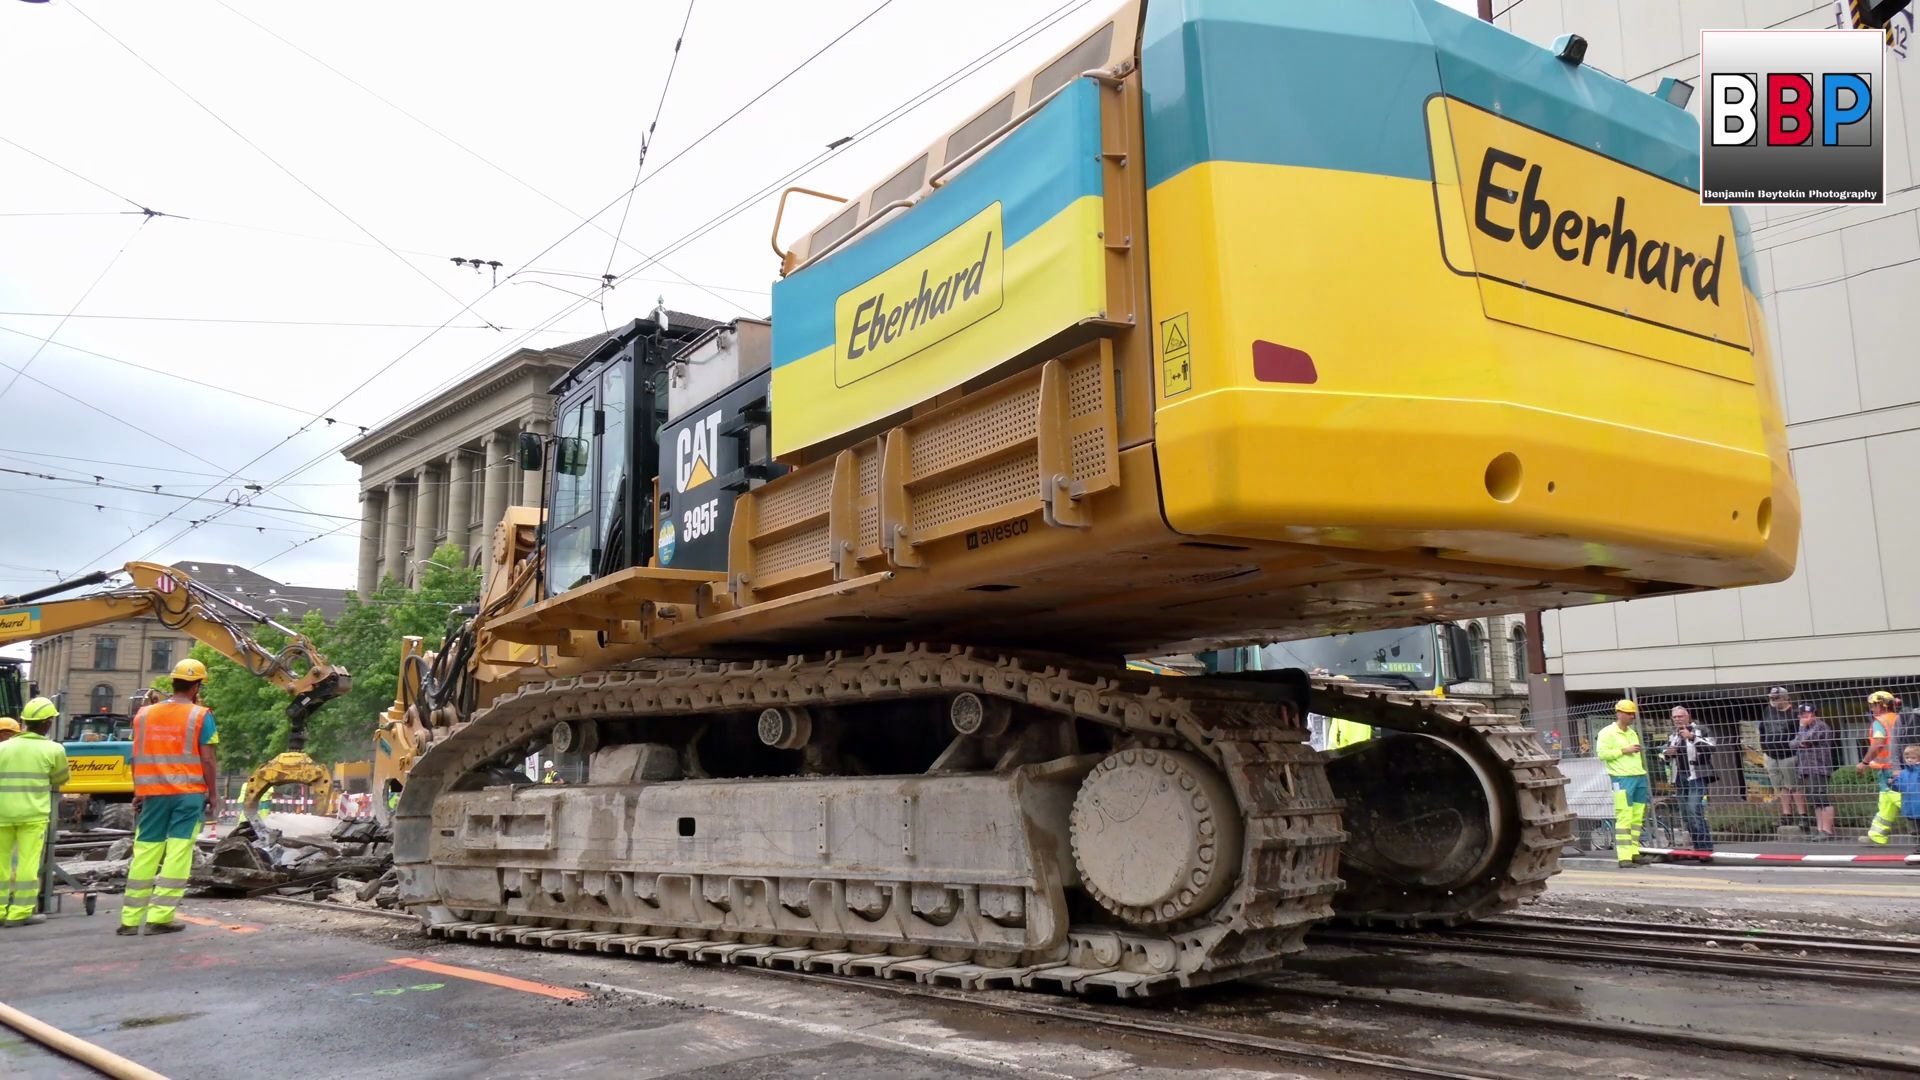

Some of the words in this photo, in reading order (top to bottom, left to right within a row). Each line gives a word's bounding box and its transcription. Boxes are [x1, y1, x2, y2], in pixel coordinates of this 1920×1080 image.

[1475, 147, 1725, 307] Eberhard
[847, 230, 992, 360] Eberhard
[676, 409, 722, 494] CAT
[683, 498, 719, 543] 395F
[980, 518, 1029, 545] avesco
